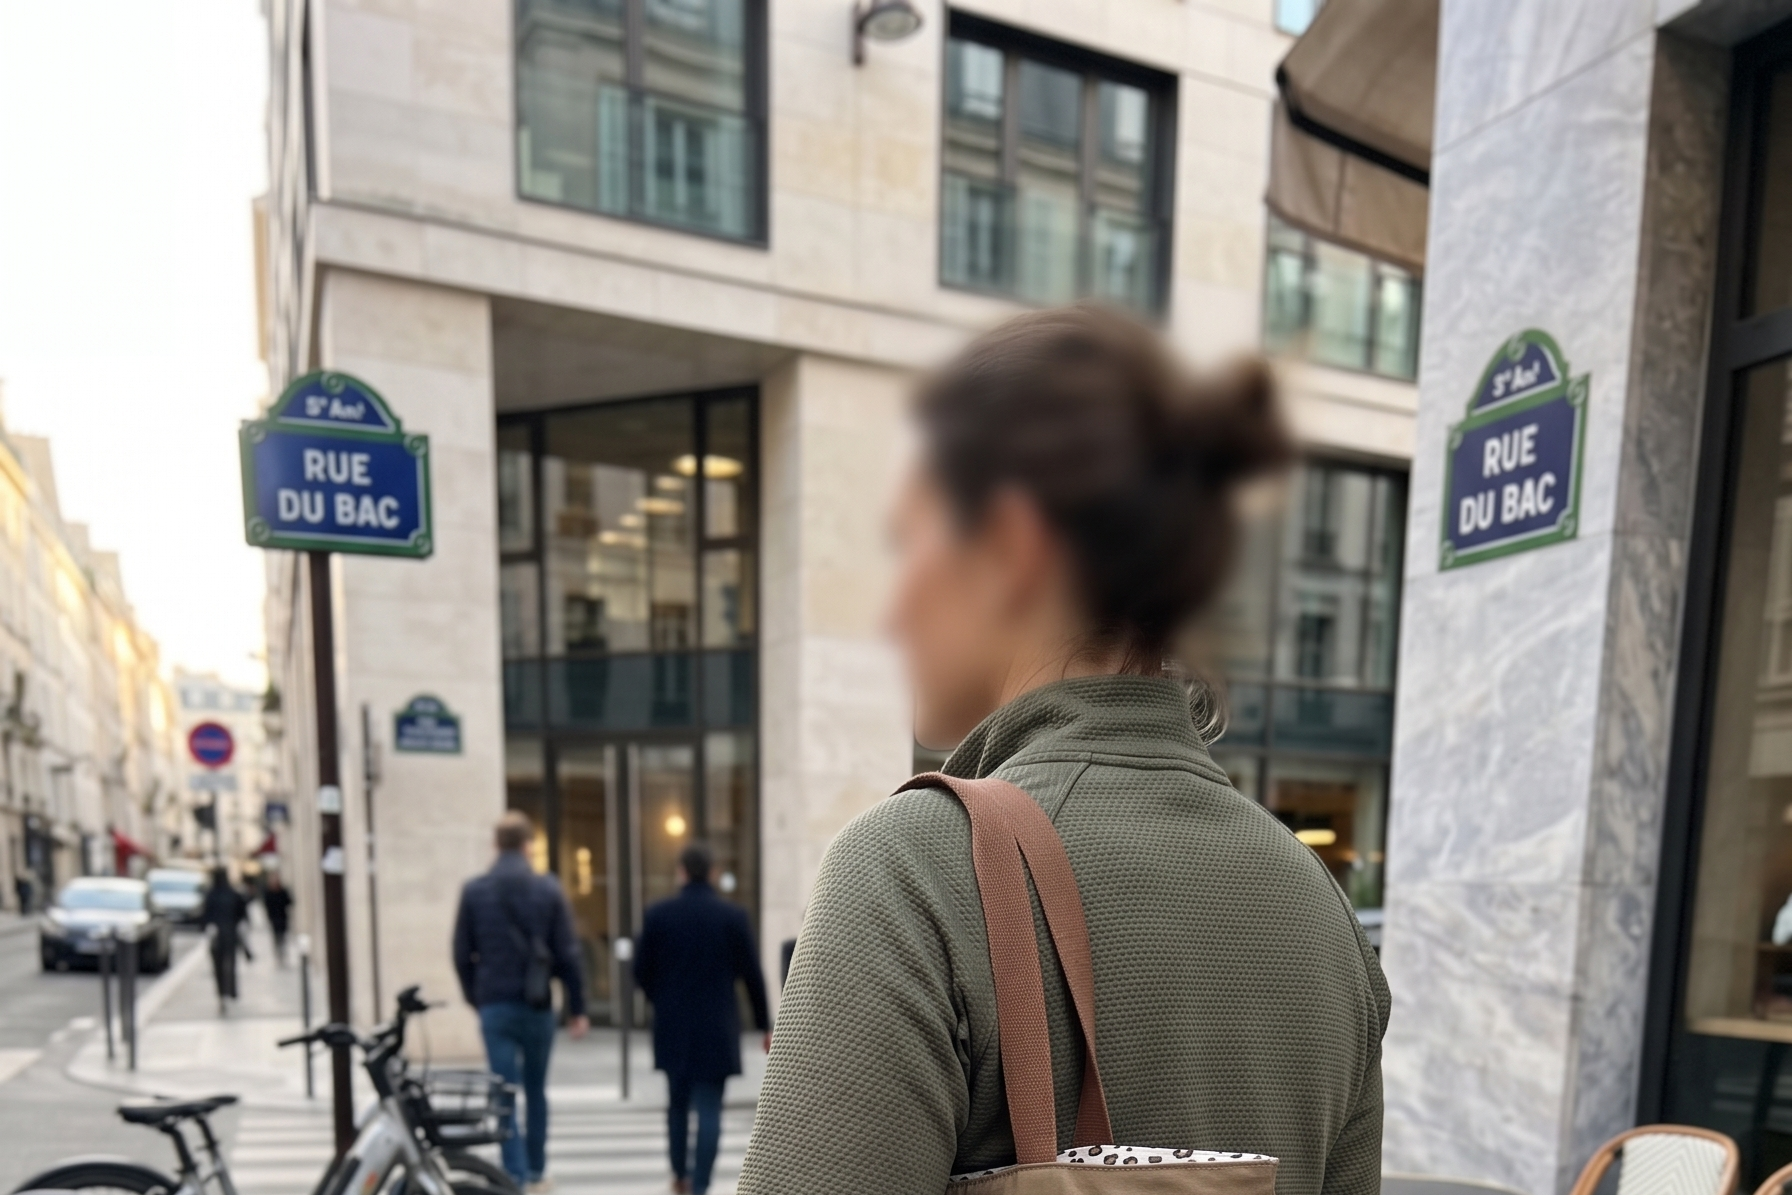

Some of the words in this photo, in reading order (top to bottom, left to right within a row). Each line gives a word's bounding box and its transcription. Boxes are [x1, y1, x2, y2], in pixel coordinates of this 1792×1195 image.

[303, 449, 371, 486] RUE
[1483, 424, 1538, 478] RUE
[278, 488, 324, 523] DU
[334, 492, 399, 530] BAC
[1459, 491, 1496, 535] DU
[1501, 472, 1556, 524] BAC
